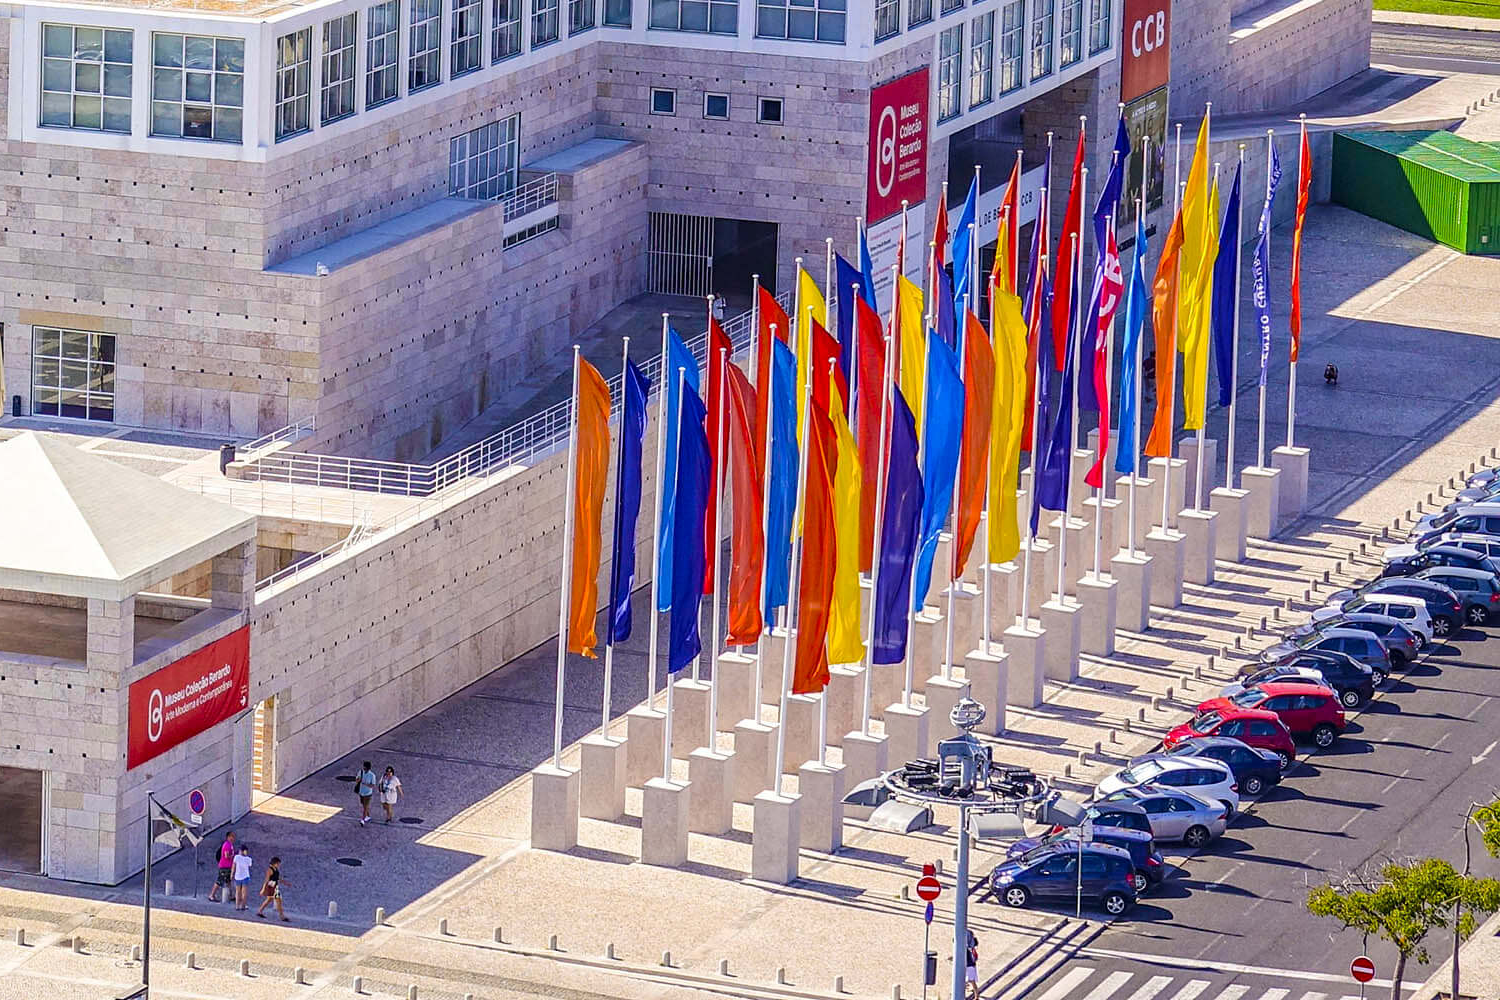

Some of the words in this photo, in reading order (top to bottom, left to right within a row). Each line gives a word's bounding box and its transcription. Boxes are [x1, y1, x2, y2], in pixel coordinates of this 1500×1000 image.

[1132, 10, 1165, 58] CCB
[900, 103, 920, 120] Museu
[899, 119, 922, 139] Coleção
[899, 137, 922, 158] Berardo
[1020, 191, 1032, 207] CCB
[165, 689, 185, 708] Museu
[186, 675, 209, 697] Coleção
[209, 663, 231, 685] Berardo
[165, 710, 175, 722] Arte
[175, 700, 196, 717] Moderna
[199, 680, 232, 705] Contemporânea
